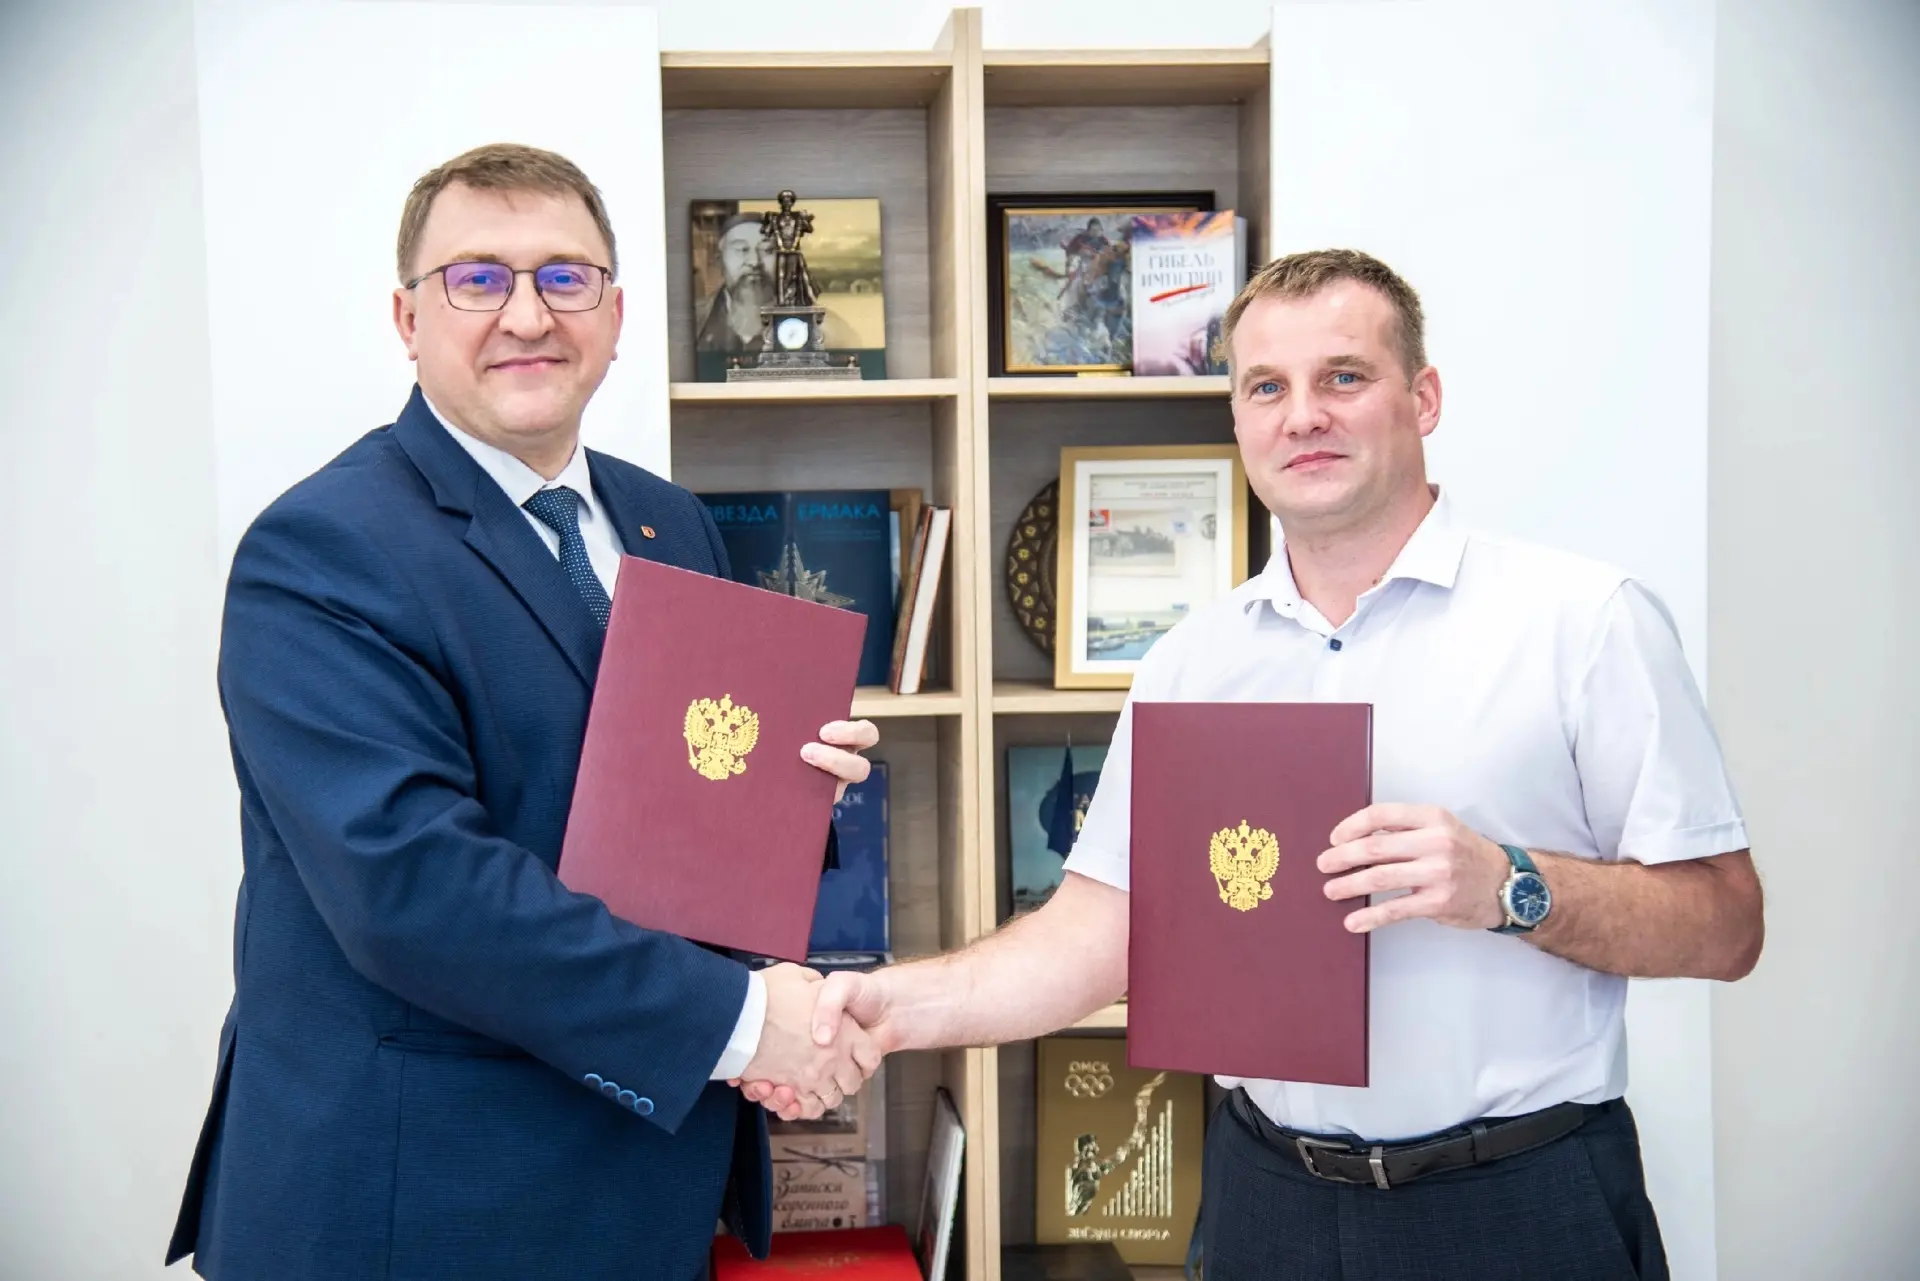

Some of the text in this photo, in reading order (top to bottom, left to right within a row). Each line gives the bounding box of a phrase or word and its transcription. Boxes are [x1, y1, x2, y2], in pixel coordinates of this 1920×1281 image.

[1149, 253, 1216, 270] ГИБЕЛЬ
[797, 503, 881, 522] ЕРМАКА
[1069, 1061, 1111, 1074] ОМСК
